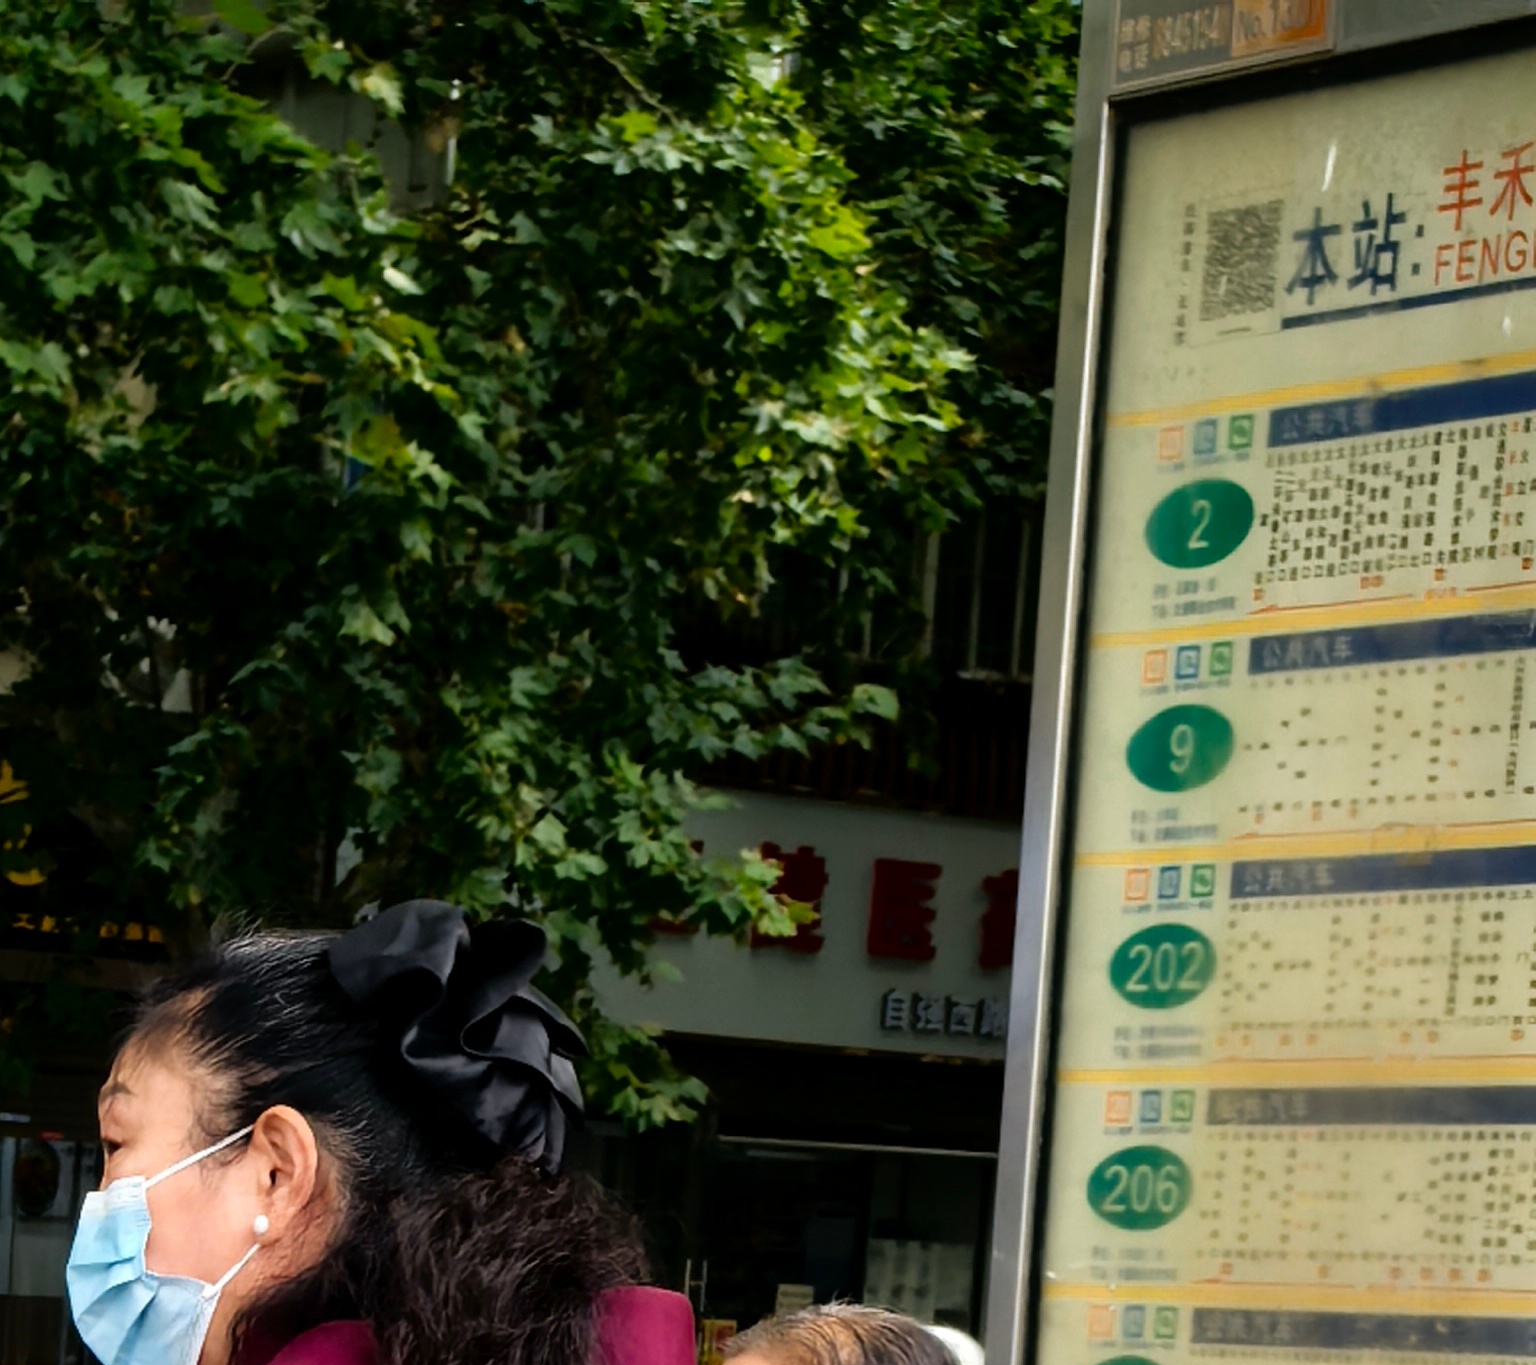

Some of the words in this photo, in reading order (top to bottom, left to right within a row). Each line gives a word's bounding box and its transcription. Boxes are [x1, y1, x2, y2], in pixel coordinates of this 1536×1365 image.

[1438, 141, 1536, 231] 丰禾
[1435, 231, 1536, 286] FENG
[1188, 500, 1212, 550] 2
[1169, 723, 1195, 773] 9
[1125, 941, 1205, 992] 202
[1102, 1163, 1180, 1214] 206
